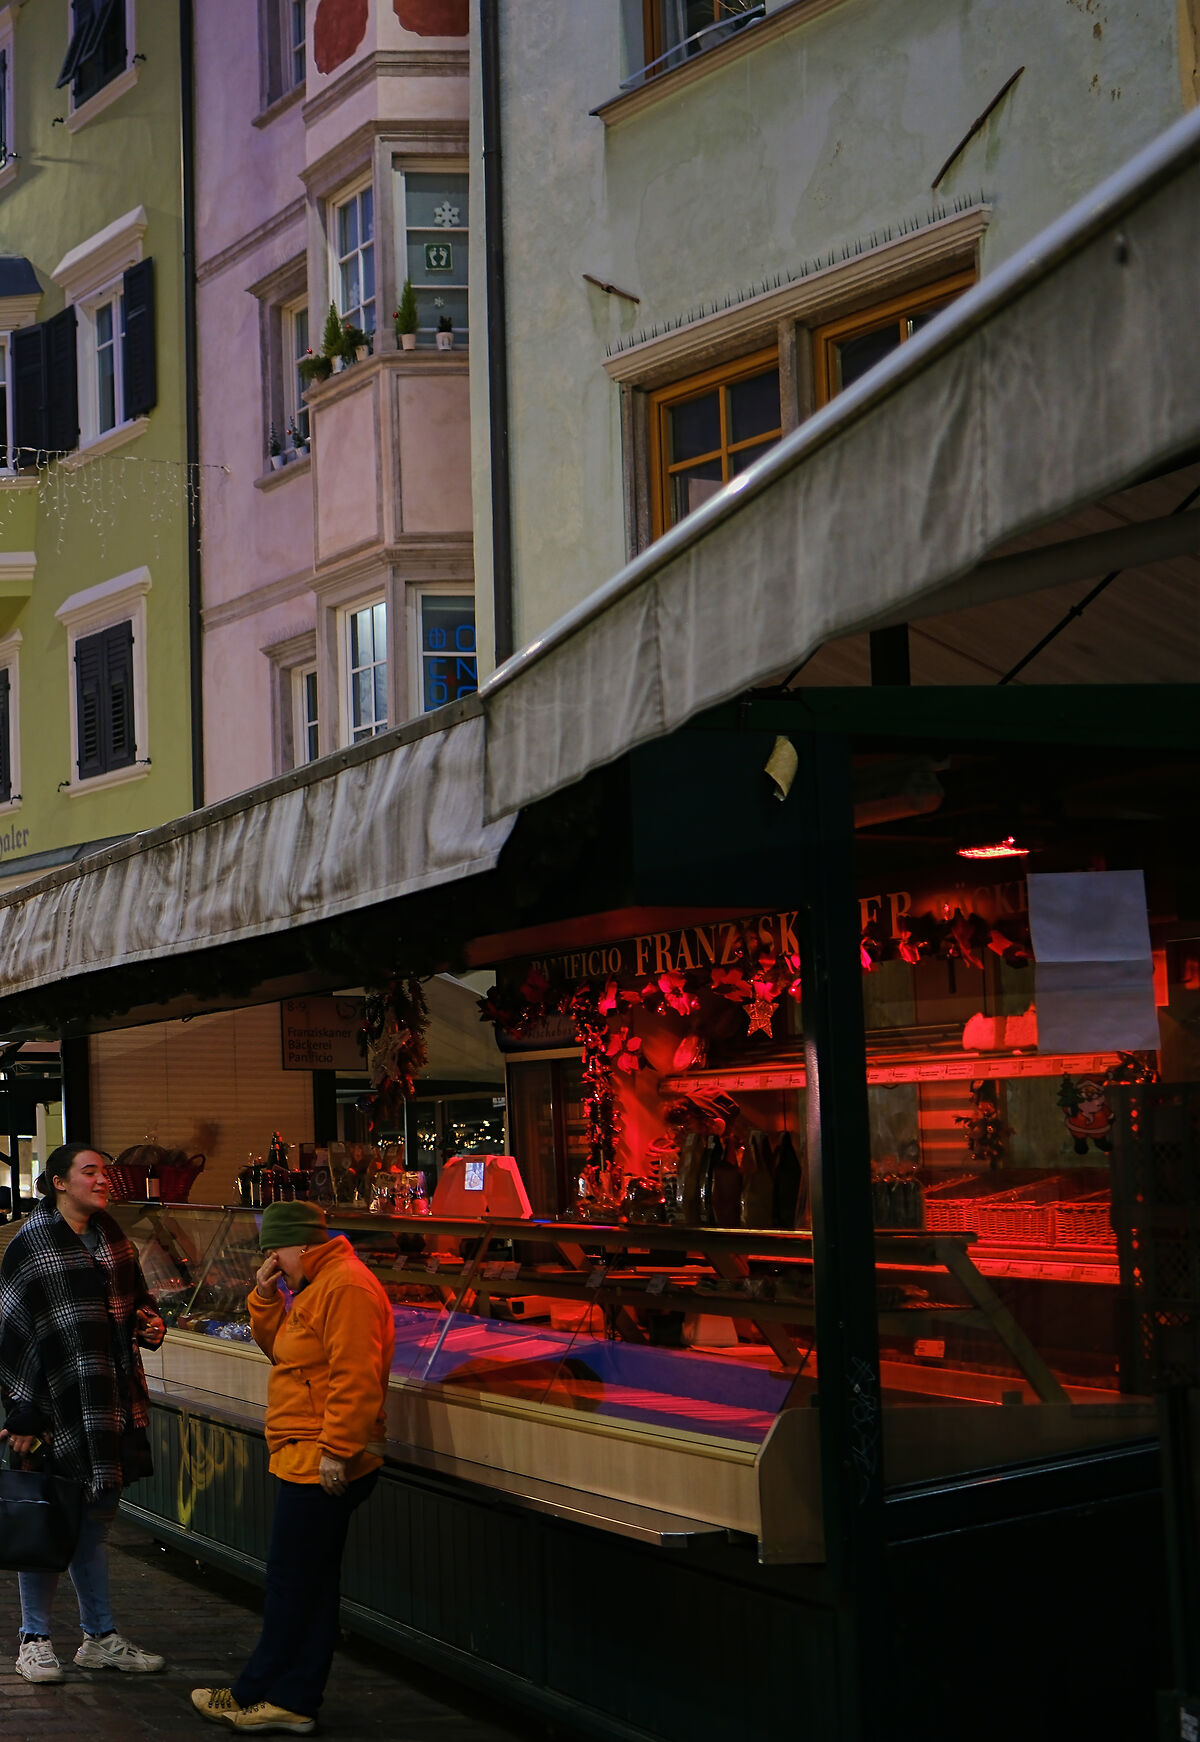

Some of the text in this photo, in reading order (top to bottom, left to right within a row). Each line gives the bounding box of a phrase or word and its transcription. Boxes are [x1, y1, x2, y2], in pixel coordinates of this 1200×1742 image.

[288, 1027, 352, 1039] Franziskaner
[288, 1040, 332, 1050] Bäckerei
[288, 1052, 333, 1064] Panificio
